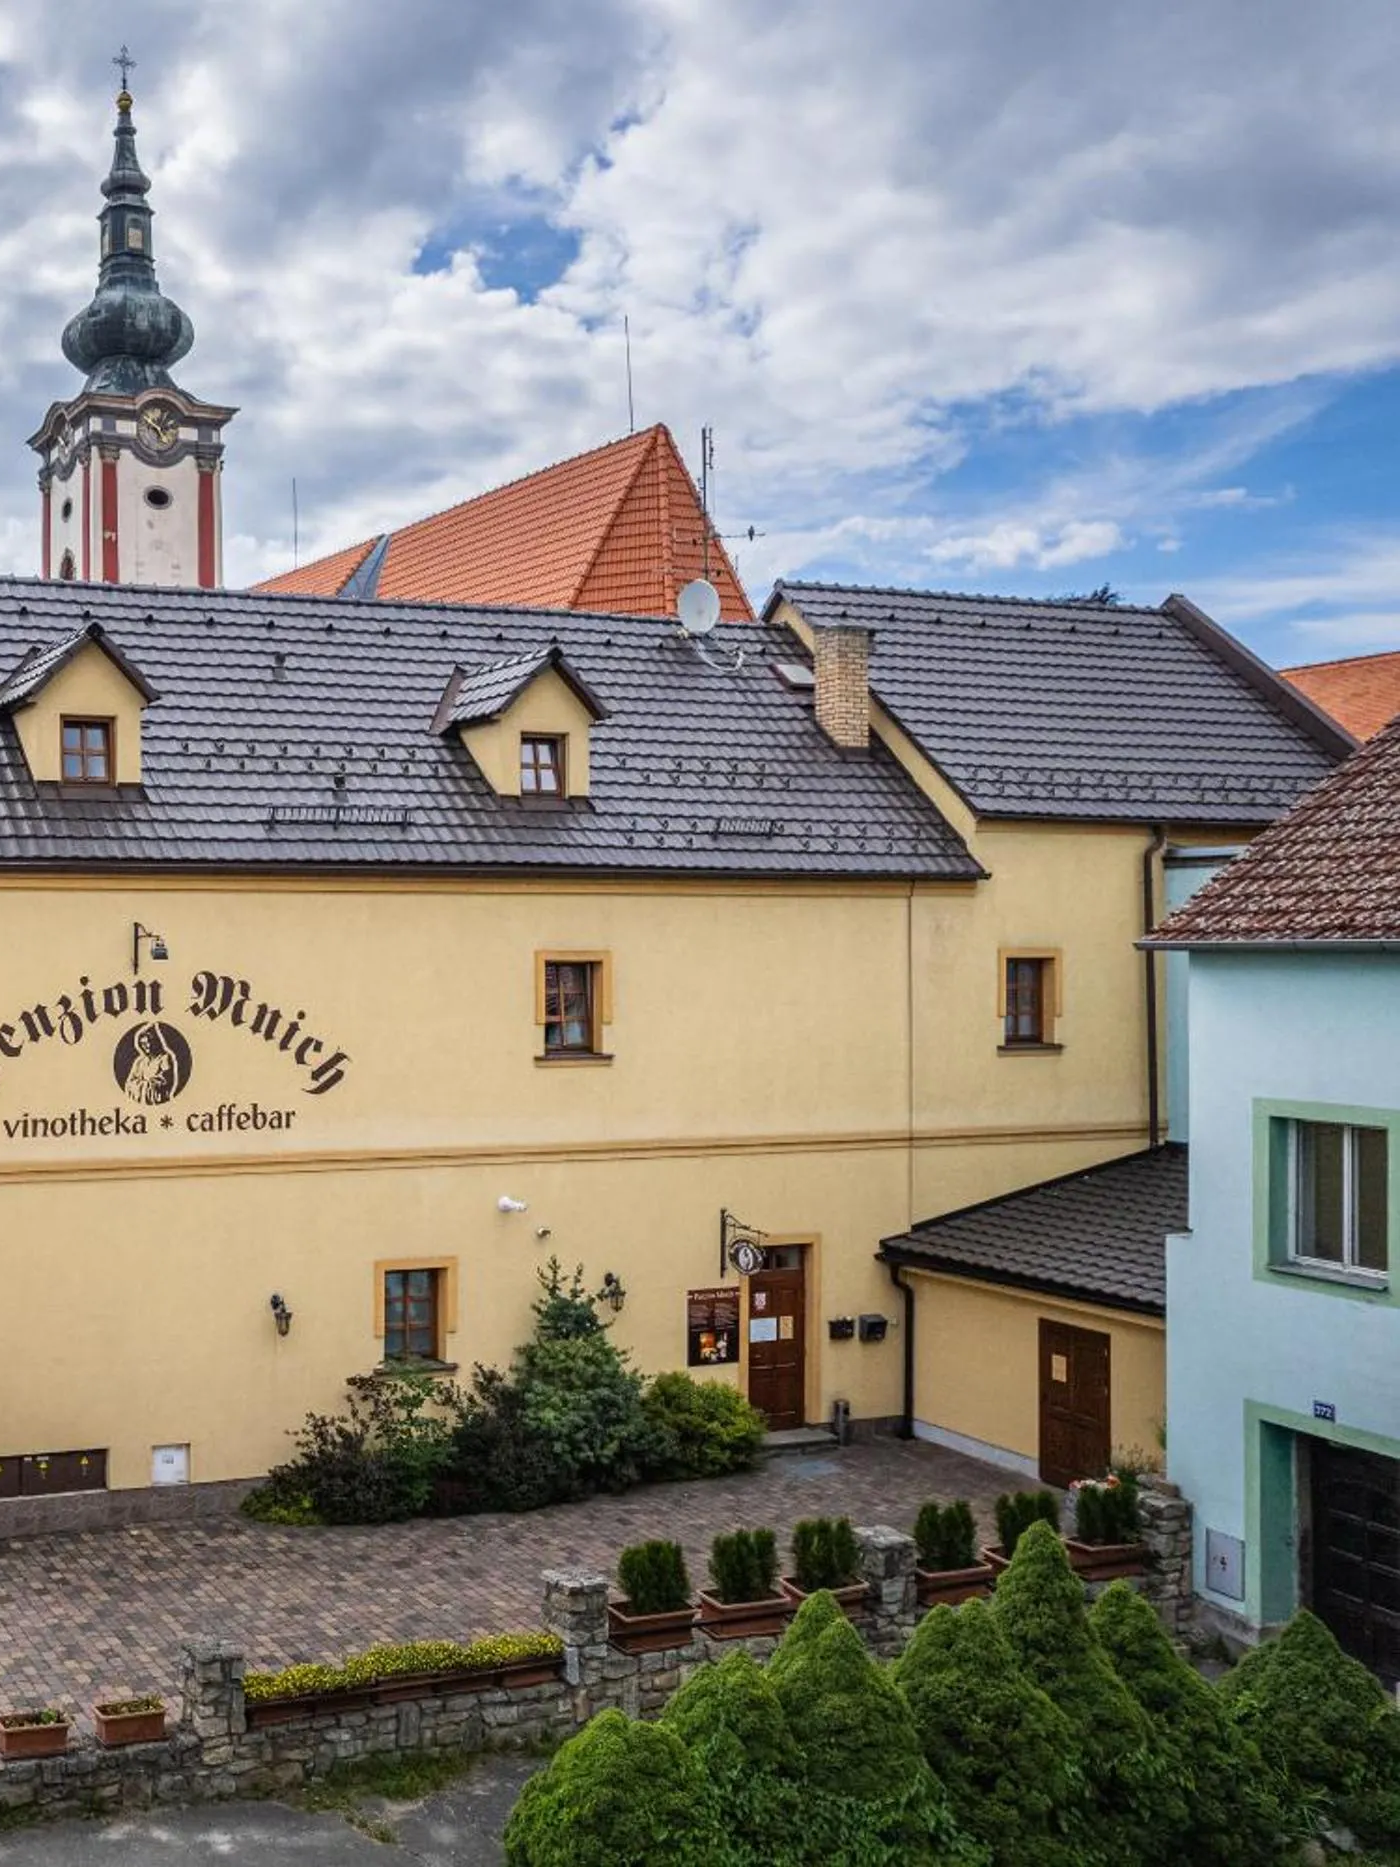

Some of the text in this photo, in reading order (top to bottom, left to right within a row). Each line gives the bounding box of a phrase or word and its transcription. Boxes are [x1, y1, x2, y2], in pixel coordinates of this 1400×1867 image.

[186, 971, 352, 1095] Mnich
[3, 1103, 296, 1138] vinotheka caffebar
